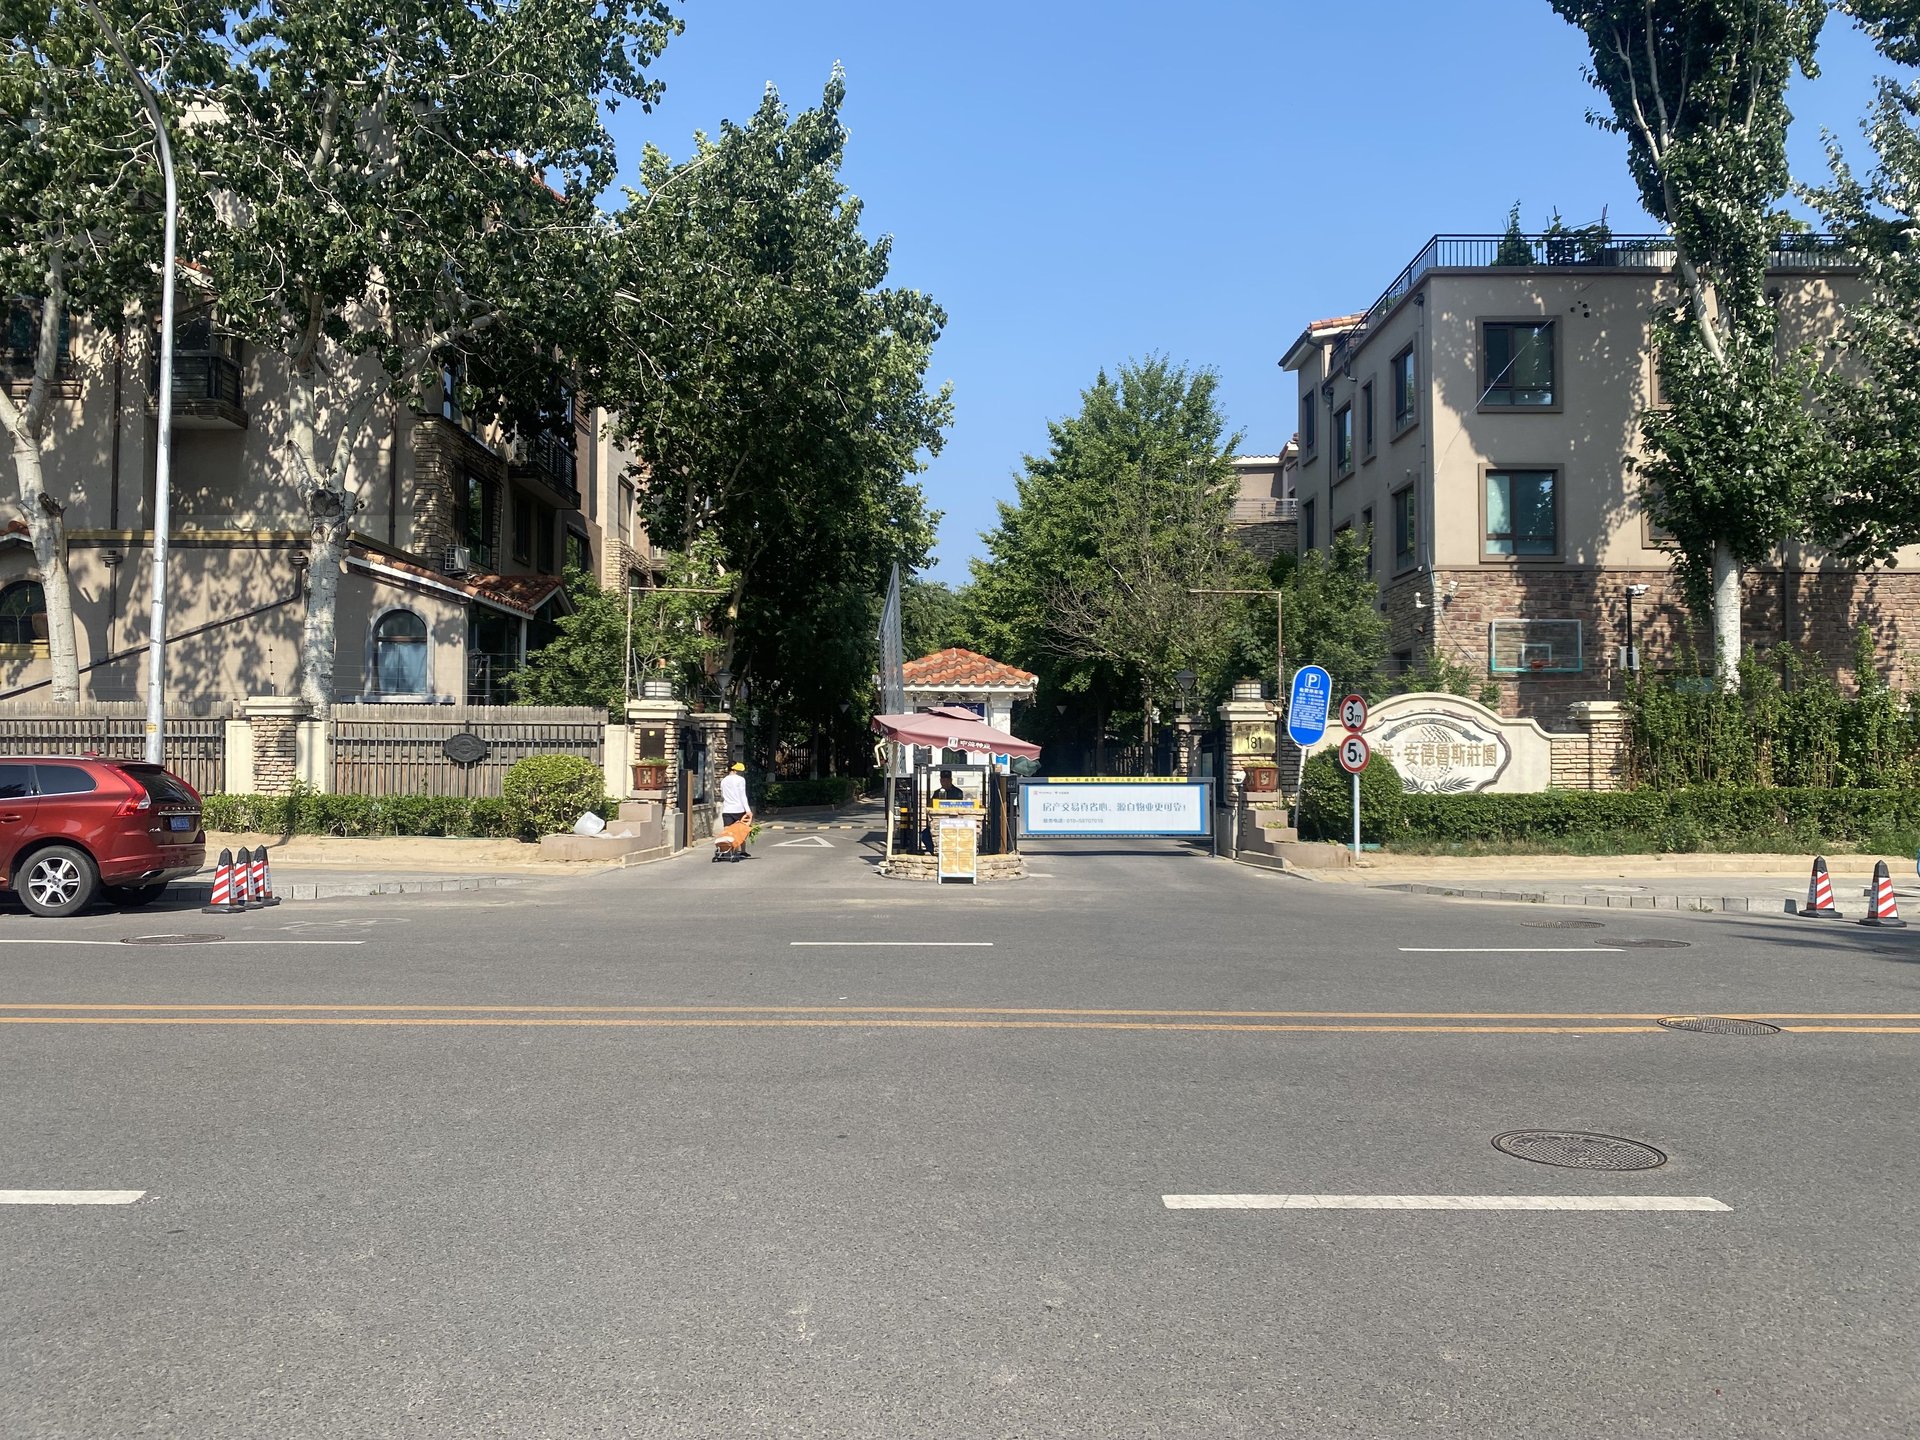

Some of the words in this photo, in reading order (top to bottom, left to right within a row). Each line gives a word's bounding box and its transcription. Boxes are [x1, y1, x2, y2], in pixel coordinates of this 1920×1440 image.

[1308, 674, 1318, 688] P
[1346, 705, 1362, 723] 3m
[1245, 736, 1262, 749] 181
[1347, 743, 1363, 763] 5t
